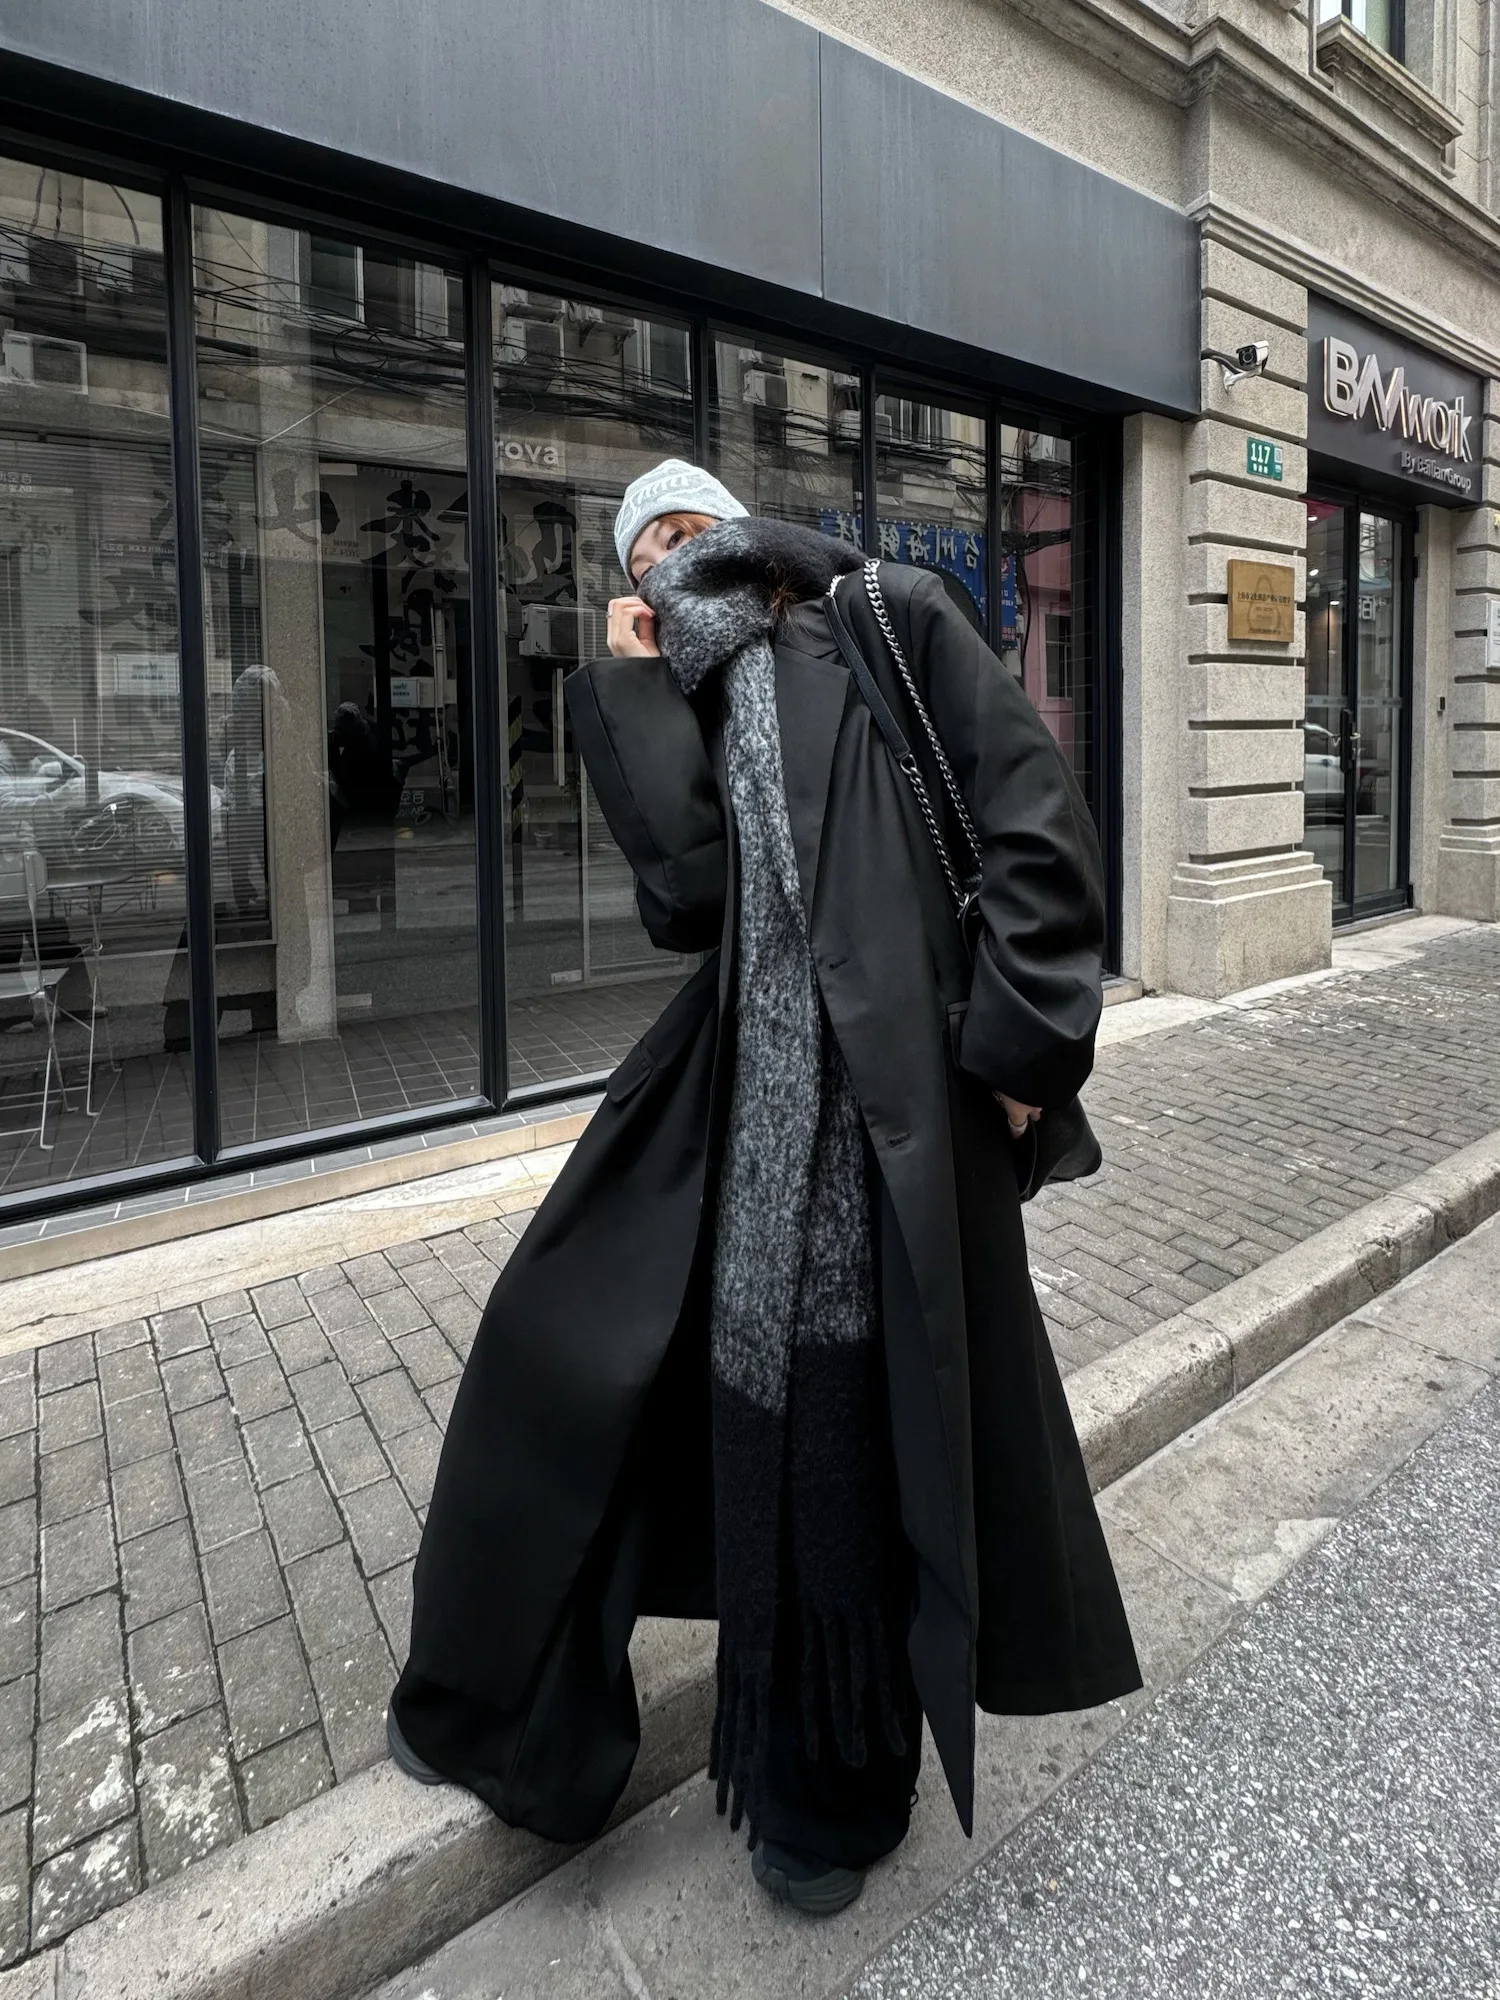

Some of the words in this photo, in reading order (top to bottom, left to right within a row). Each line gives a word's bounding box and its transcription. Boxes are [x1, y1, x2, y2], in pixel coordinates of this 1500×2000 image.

[1250, 442, 1271, 465] 117
[1401, 451, 1416, 474] By
[1446, 468, 1472, 494] Group
